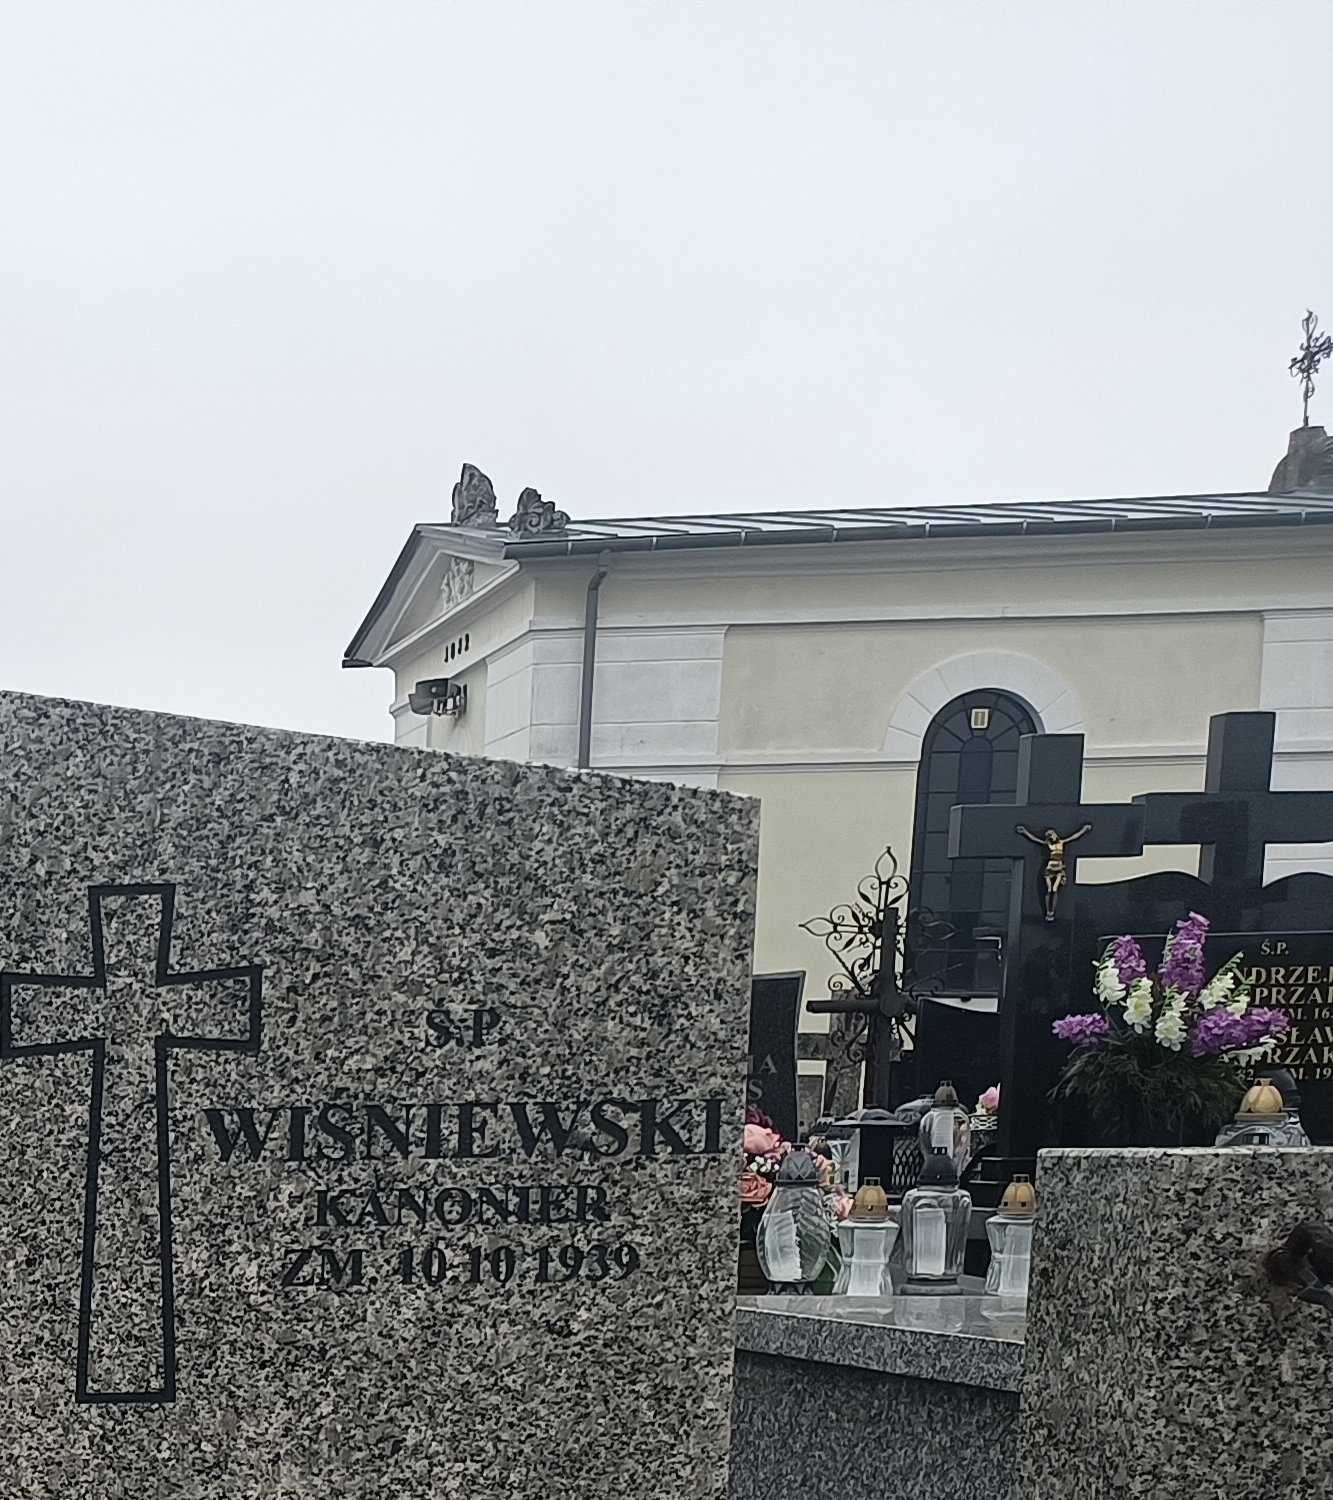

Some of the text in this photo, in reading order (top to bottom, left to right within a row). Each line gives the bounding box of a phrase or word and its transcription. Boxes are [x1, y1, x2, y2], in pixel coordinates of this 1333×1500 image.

[1261, 938, 1289, 954] Ś.P.
[205, 1090, 727, 1162] WIŚNIEWSKI
[313, 1184, 612, 1228] KANONIER
